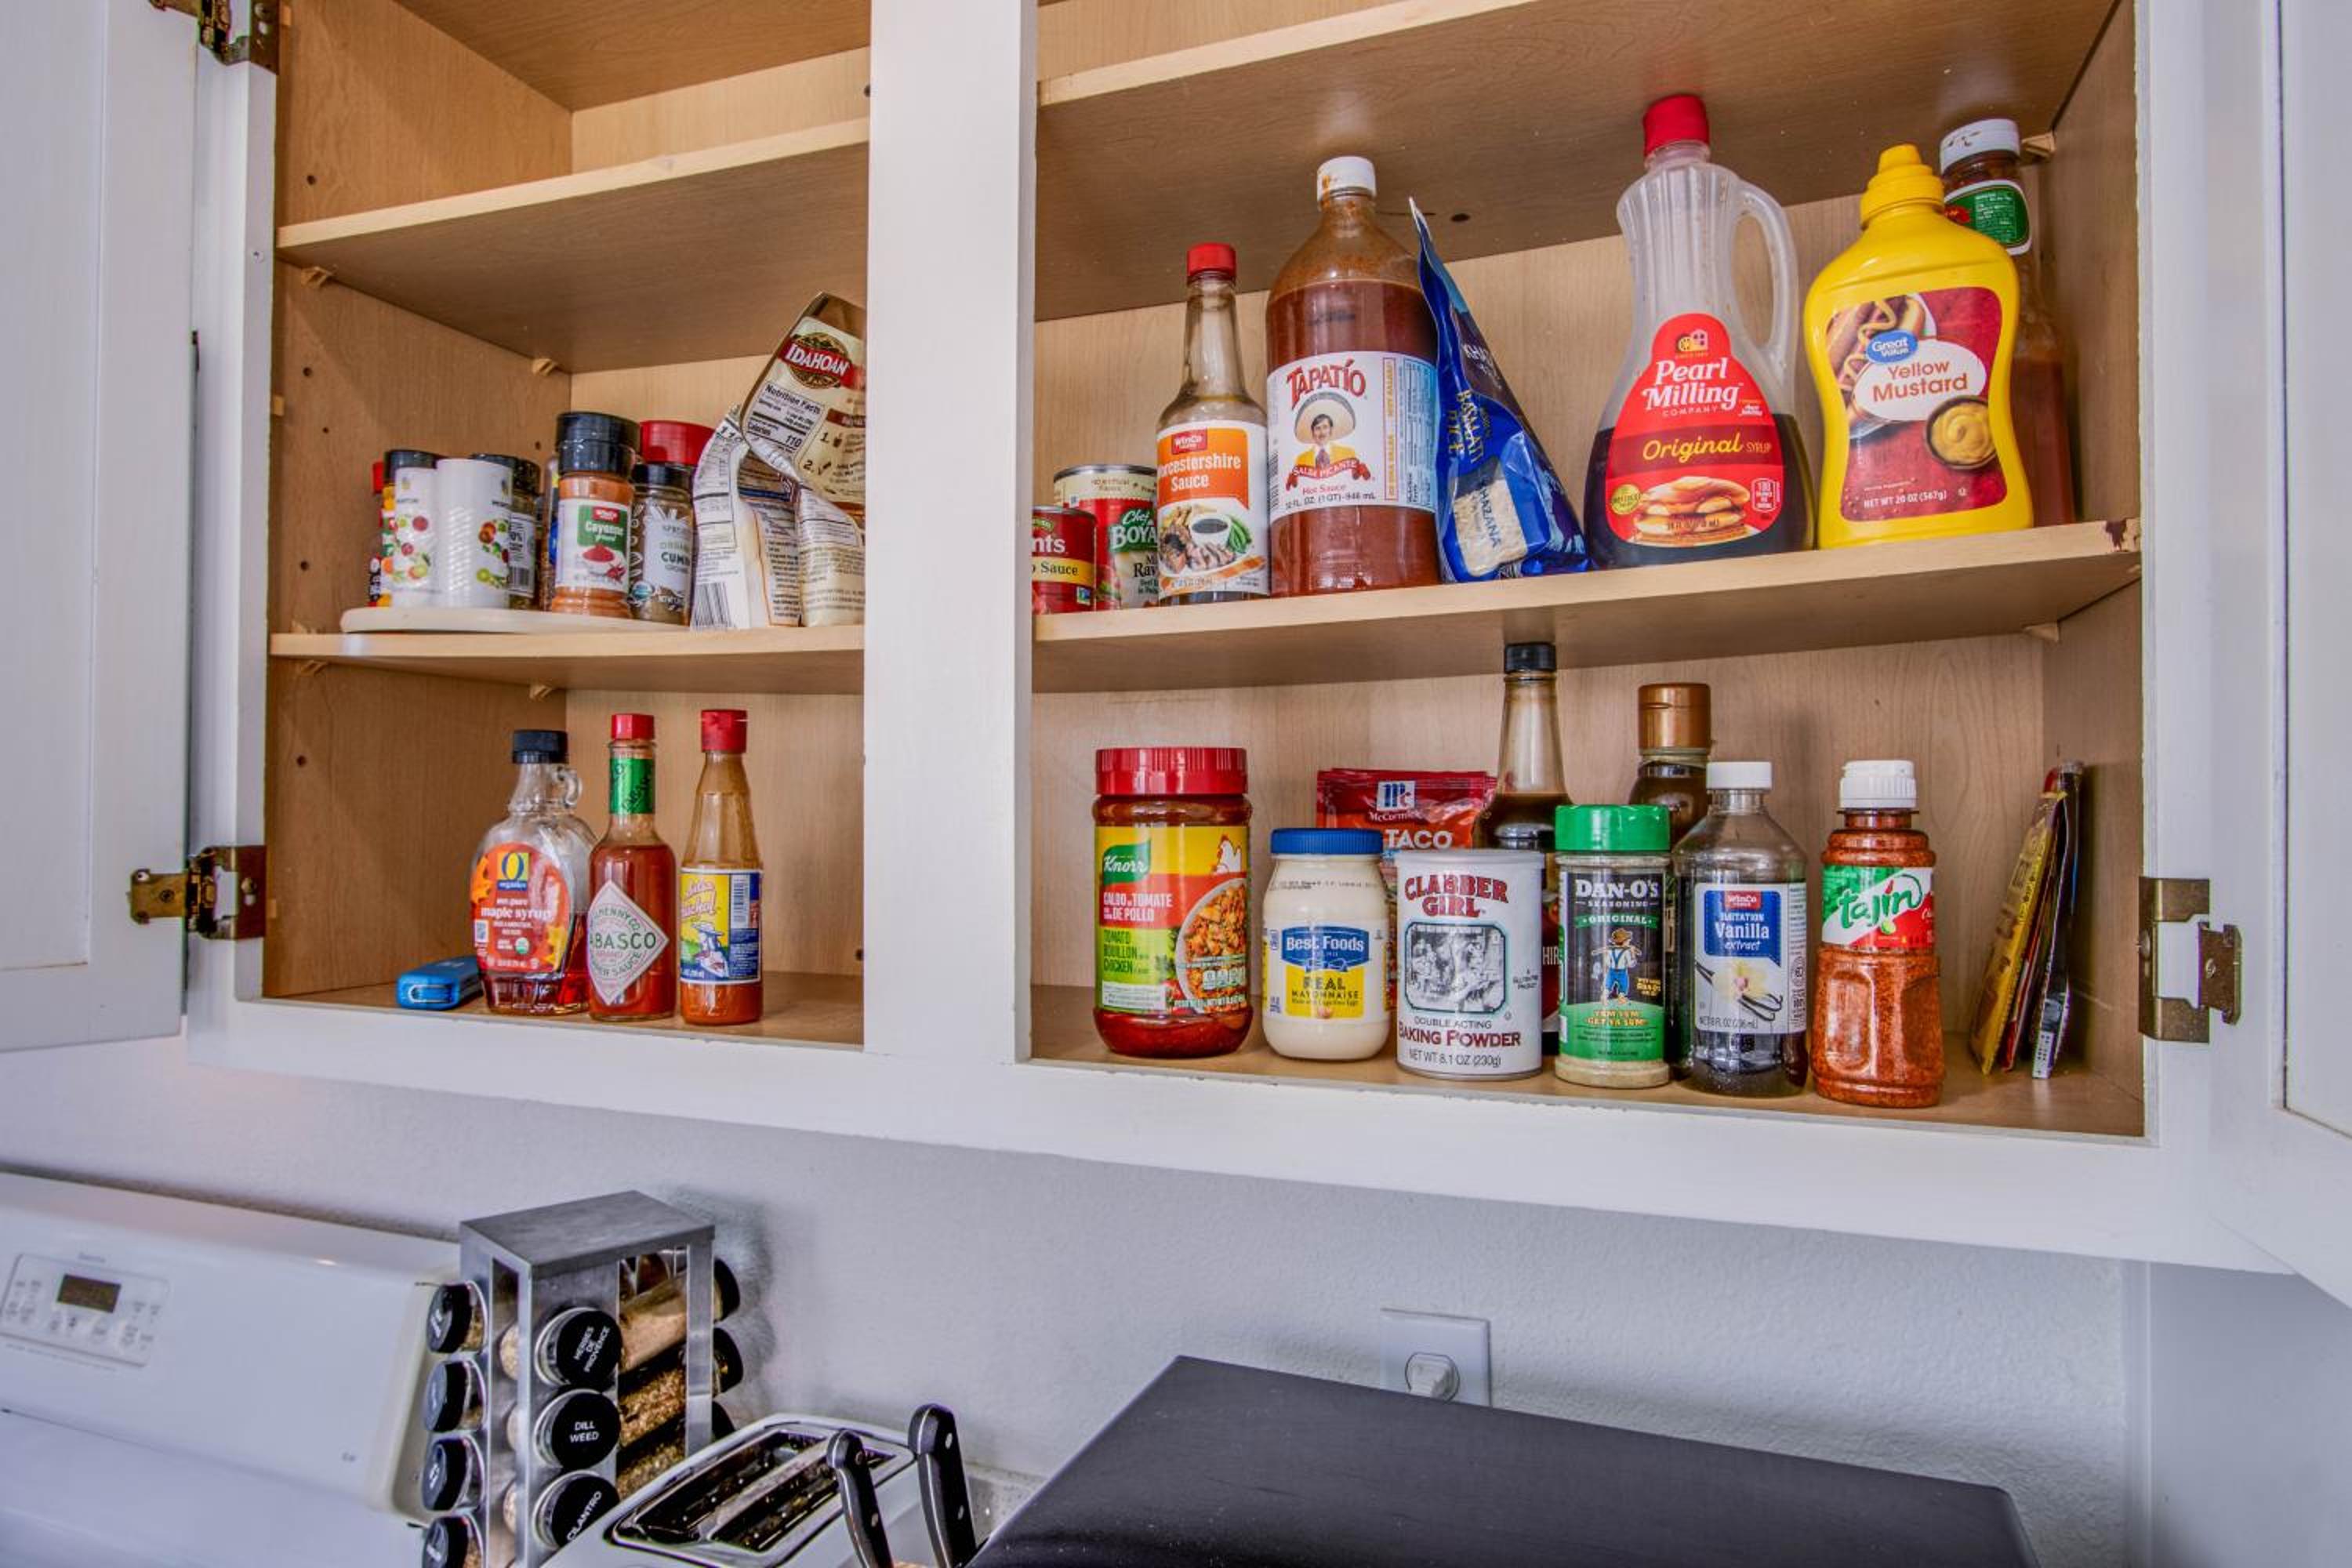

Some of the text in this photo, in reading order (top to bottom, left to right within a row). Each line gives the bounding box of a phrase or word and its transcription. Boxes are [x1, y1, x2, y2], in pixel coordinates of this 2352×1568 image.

[1871, 337, 1908, 351] Great
[785, 343, 850, 376] IDAHOAN
[1655, 356, 1729, 385] Pearl
[1887, 360, 1951, 380] Yellow
[1873, 373, 1969, 402] Mustard
[765, 384, 800, 405] Nutrition
[800, 401, 821, 415] Facts
[1642, 382, 1740, 411] Milling
[1662, 405, 1719, 418] COMPANY
[786, 435, 802, 448] 110
[1642, 432, 1744, 463] Original
[1158, 452, 1242, 477] orcestershire
[1171, 474, 1210, 492] Sauce
[1303, 484, 1348, 495] Hot Sauce
[1907, 493, 1918, 503] OZ
[1123, 510, 1151, 525] Chef
[1032, 535, 1066, 554] nts
[1111, 525, 1158, 549] BOYA
[1040, 561, 1079, 576] Sauce
[1134, 563, 1157, 578] Rav
[1368, 809, 1424, 822] McCormick
[1385, 829, 1454, 850] TACO
[1104, 855, 1148, 873] Knorr
[1404, 874, 1509, 903] CLABBER
[1104, 891, 1127, 906] CALDO
[1132, 892, 1174, 908] TOMATE
[1421, 895, 1481, 918] GIRL
[481, 907, 553, 922] maple syrup
[1124, 907, 1155, 922] POLLO
[1588, 915, 1647, 924] ORIGINAL
[1720, 913, 1765, 922] IMITATION
[1715, 923, 1770, 939] Vanilla
[590, 931, 656, 950] BASCO
[1286, 935, 1366, 953] Best Foods
[1725, 940, 1761, 951] extract
[1302, 976, 1347, 991] REAL
[1291, 990, 1359, 1000] MAYONNAISE
[1414, 1015, 1493, 1030] DOUBLE ACTING
[1399, 1022, 1521, 1048] BAKING POWDER
[1409, 1048, 1502, 1069] NET WT 8.1 OZ (230g)
[573, 1326, 594, 1361] HERBES
[583, 1326, 611, 1374] PROVENCE
[575, 1421, 596, 1431] DILL
[569, 1431, 600, 1443] WEED
